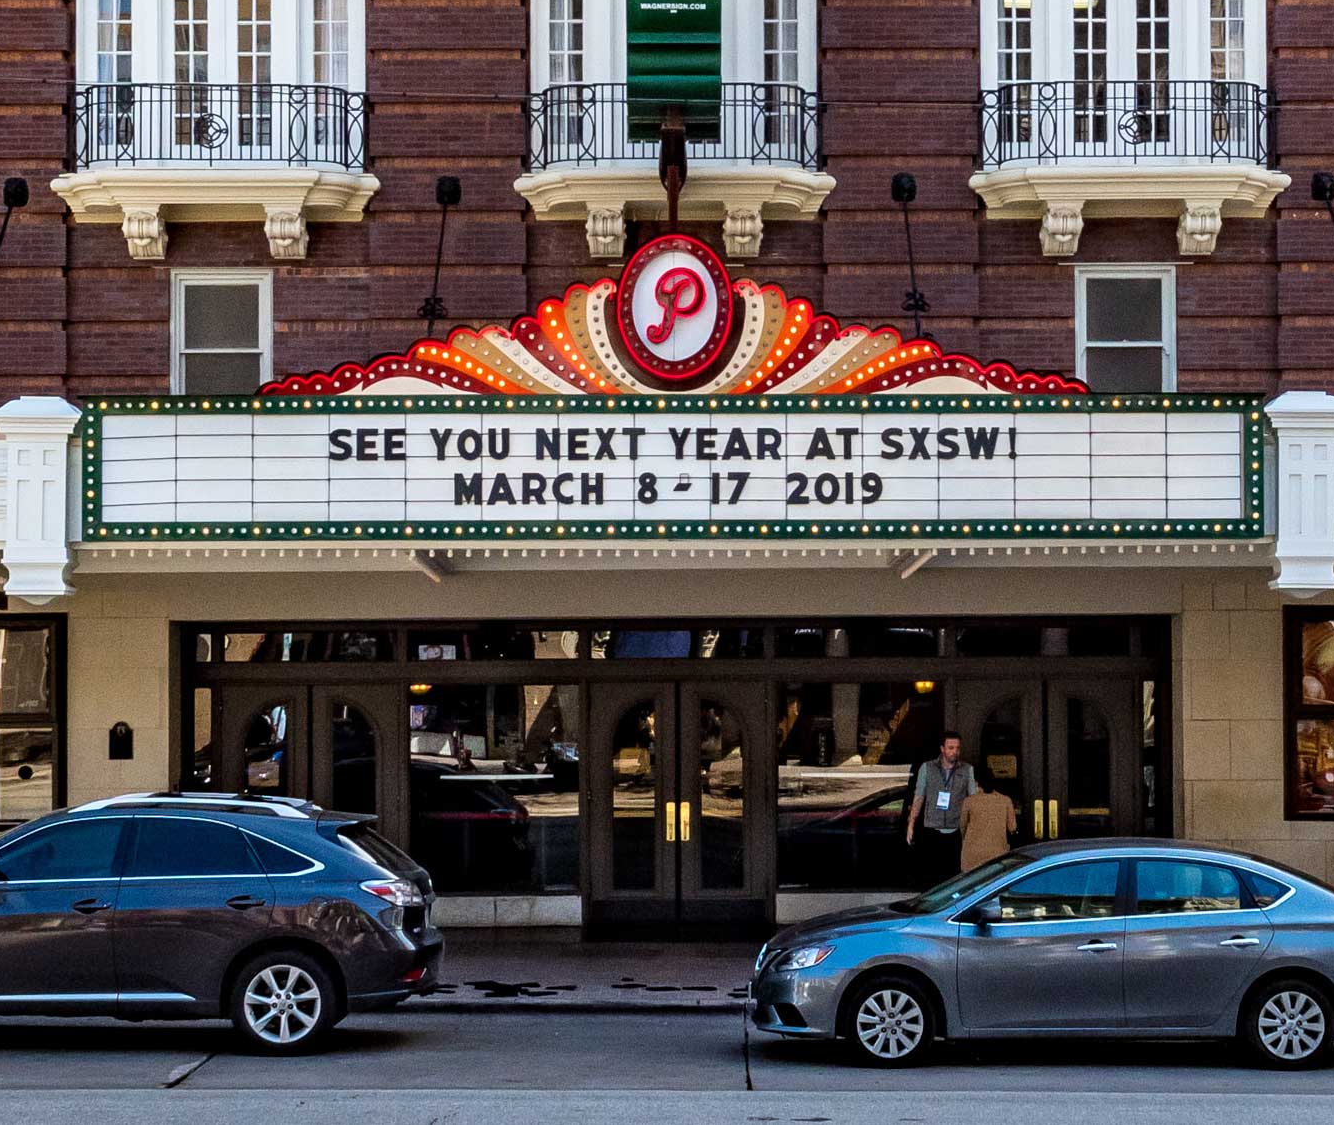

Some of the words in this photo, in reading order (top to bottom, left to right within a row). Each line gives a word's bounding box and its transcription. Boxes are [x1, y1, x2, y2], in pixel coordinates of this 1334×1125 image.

[640, 2, 707, 10] WAGNERSIGN.COM
[646, 267, 707, 344] P
[328, 428, 407, 461] SEE
[430, 428, 511, 461] YOU
[535, 427, 646, 461] NEXT
[668, 427, 782, 461] YEAR
[806, 427, 860, 461] AT
[880, 427, 1017, 461] SXSW!
[454, 472, 605, 506] MARCH
[786, 472, 883, 505] 2019
